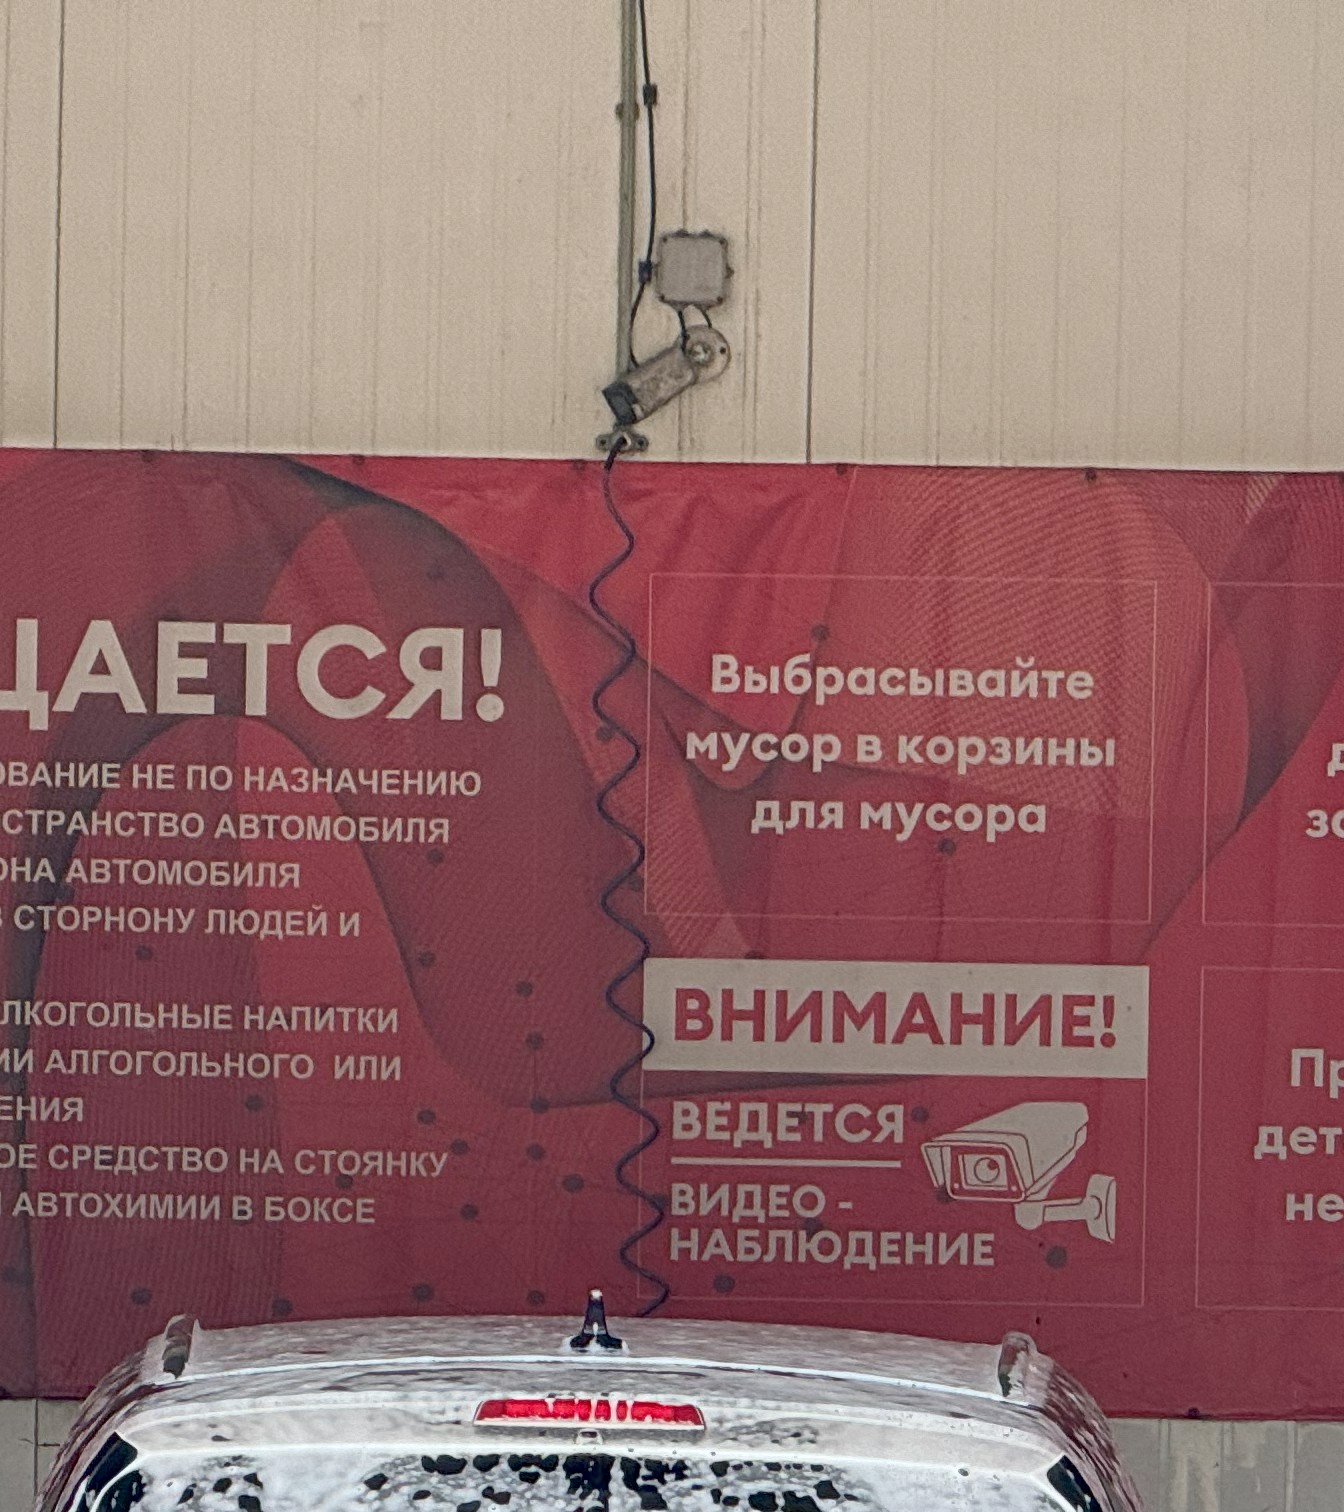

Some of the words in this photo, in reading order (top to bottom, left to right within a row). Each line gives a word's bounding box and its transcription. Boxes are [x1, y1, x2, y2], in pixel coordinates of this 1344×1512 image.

[711, 653, 1095, 706] Выбрасывайте
[686, 731, 842, 773] мусор
[856, 734, 883, 763] в
[897, 735, 1116, 776] корзины
[132, 763, 175, 790] НЕ
[186, 764, 233, 791] ПО
[244, 766, 482, 797] НАЗНАЧЕНИЮ
[214, 813, 450, 844] АВТОМОБИЛЯ
[750, 800, 844, 835] для
[860, 801, 1047, 844] мусора
[65, 858, 300, 888] АВТОМОБИЛЯ
[13, 904, 196, 934] СТОРНОНУ
[204, 904, 328, 940] ЛЮДЕЙ
[339, 911, 360, 937] И
[243, 1005, 398, 1034] НАПИТКИ
[674, 987, 1117, 1049] ВНИМАНИЕ!
[44, 1049, 315, 1080] АЛГОГОЛЬНОГО
[334, 1054, 401, 1081] ИЛИ
[672, 1100, 905, 1149] ВЕДЕТСЯ
[48, 1143, 229, 1176] СРЕДСТВО
[239, 1147, 285, 1174] НА
[294, 1149, 449, 1178] СТОЯНКУ
[11, 1191, 221, 1221] АВТОХИМИИ
[232, 1195, 253, 1221] В
[264, 1196, 376, 1224] БОКСЕ
[671, 1182, 826, 1224] ВИДЕО
[670, 1227, 995, 1271] НАБЛЮДЕНИЕ
